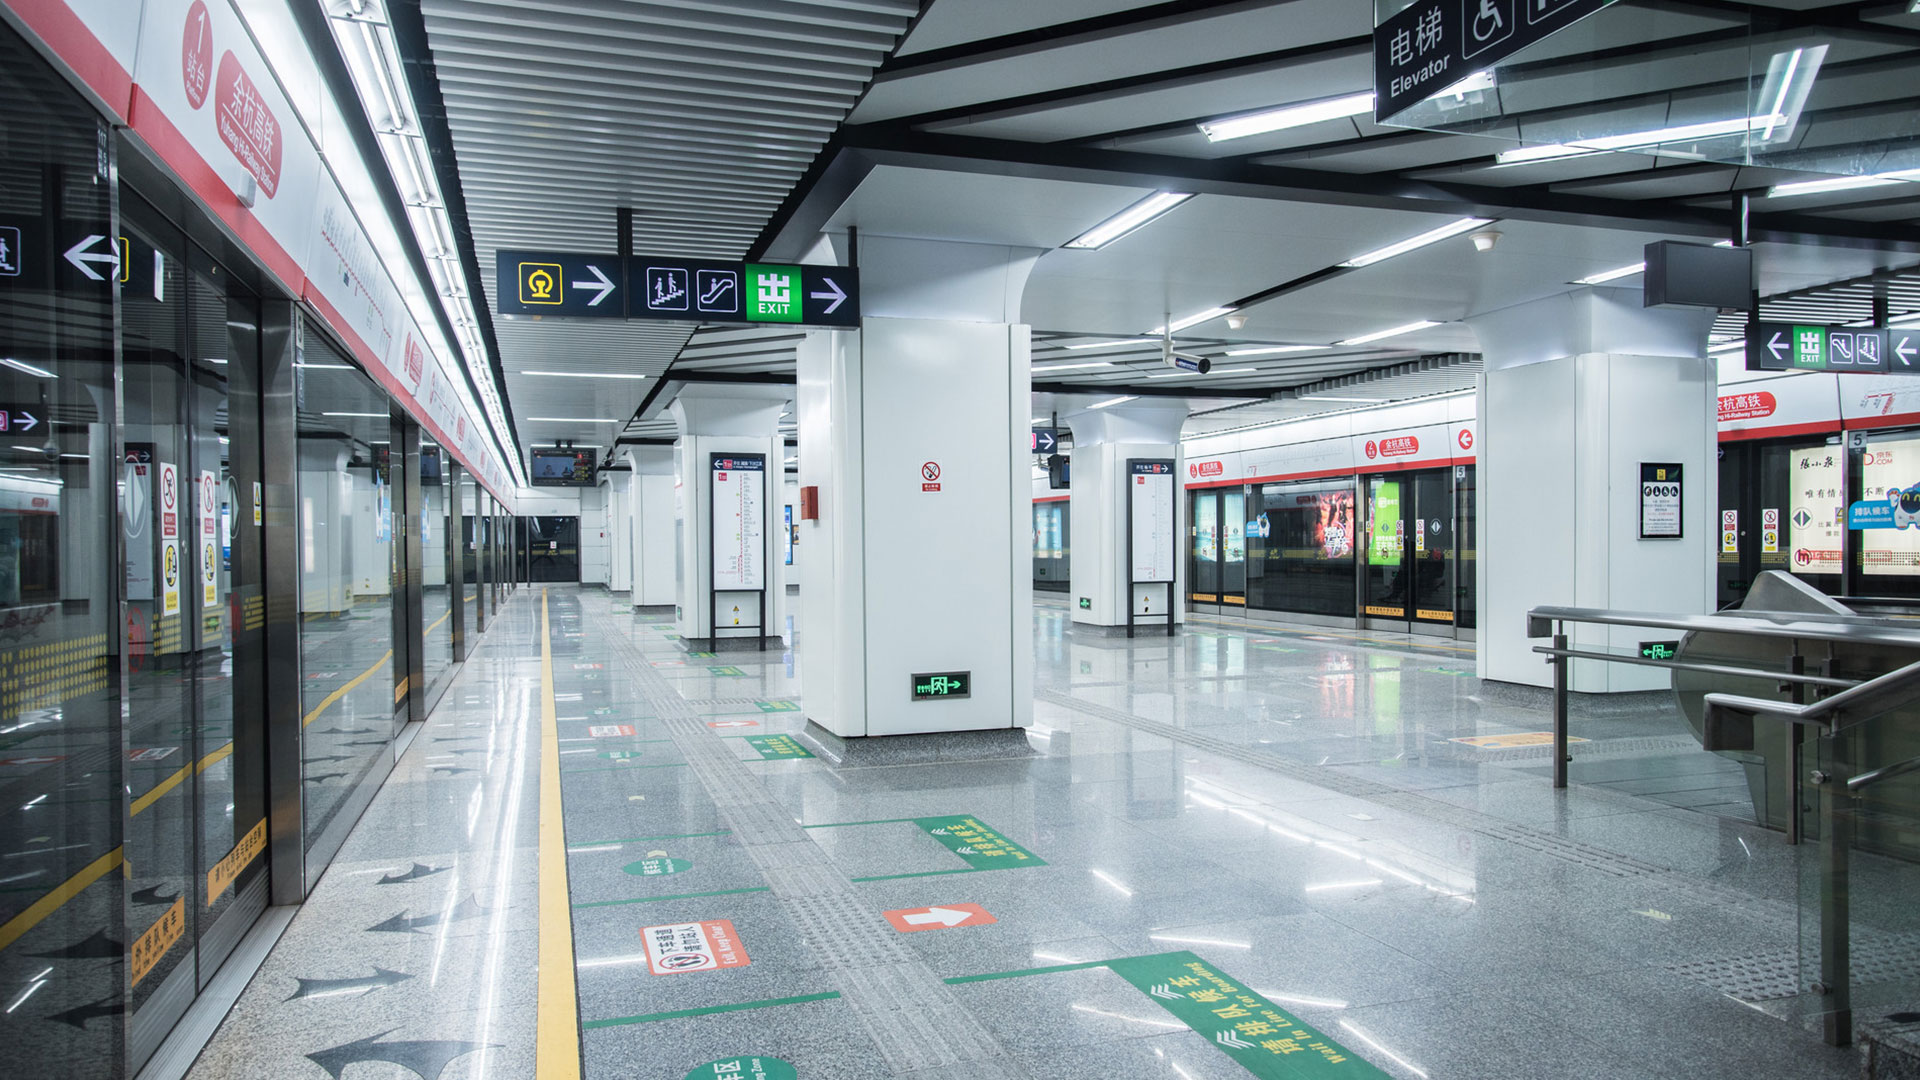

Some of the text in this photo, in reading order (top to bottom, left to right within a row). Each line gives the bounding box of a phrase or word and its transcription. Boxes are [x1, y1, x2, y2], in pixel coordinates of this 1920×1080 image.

[198, 10, 206, 53] 1
[1390, 6, 1442, 67] 电梯
[187, 50, 205, 92] 站台
[1390, 54, 1450, 98] Elevator
[230, 72, 274, 161] 余杭高铁
[260, 163, 274, 195] Station
[758, 302, 791, 315] EXIT
[1800, 354, 1819, 363] EXIT
[1853, 434, 1863, 447] 5
[1458, 466, 1464, 476] 5
[947, 825, 1007, 856] 请排队候车
[1168, 975, 1305, 1055] 请排队候车
[1184, 961, 1347, 1064] Wait In Line For Boarding
[751, 1058, 763, 1073] Zone
